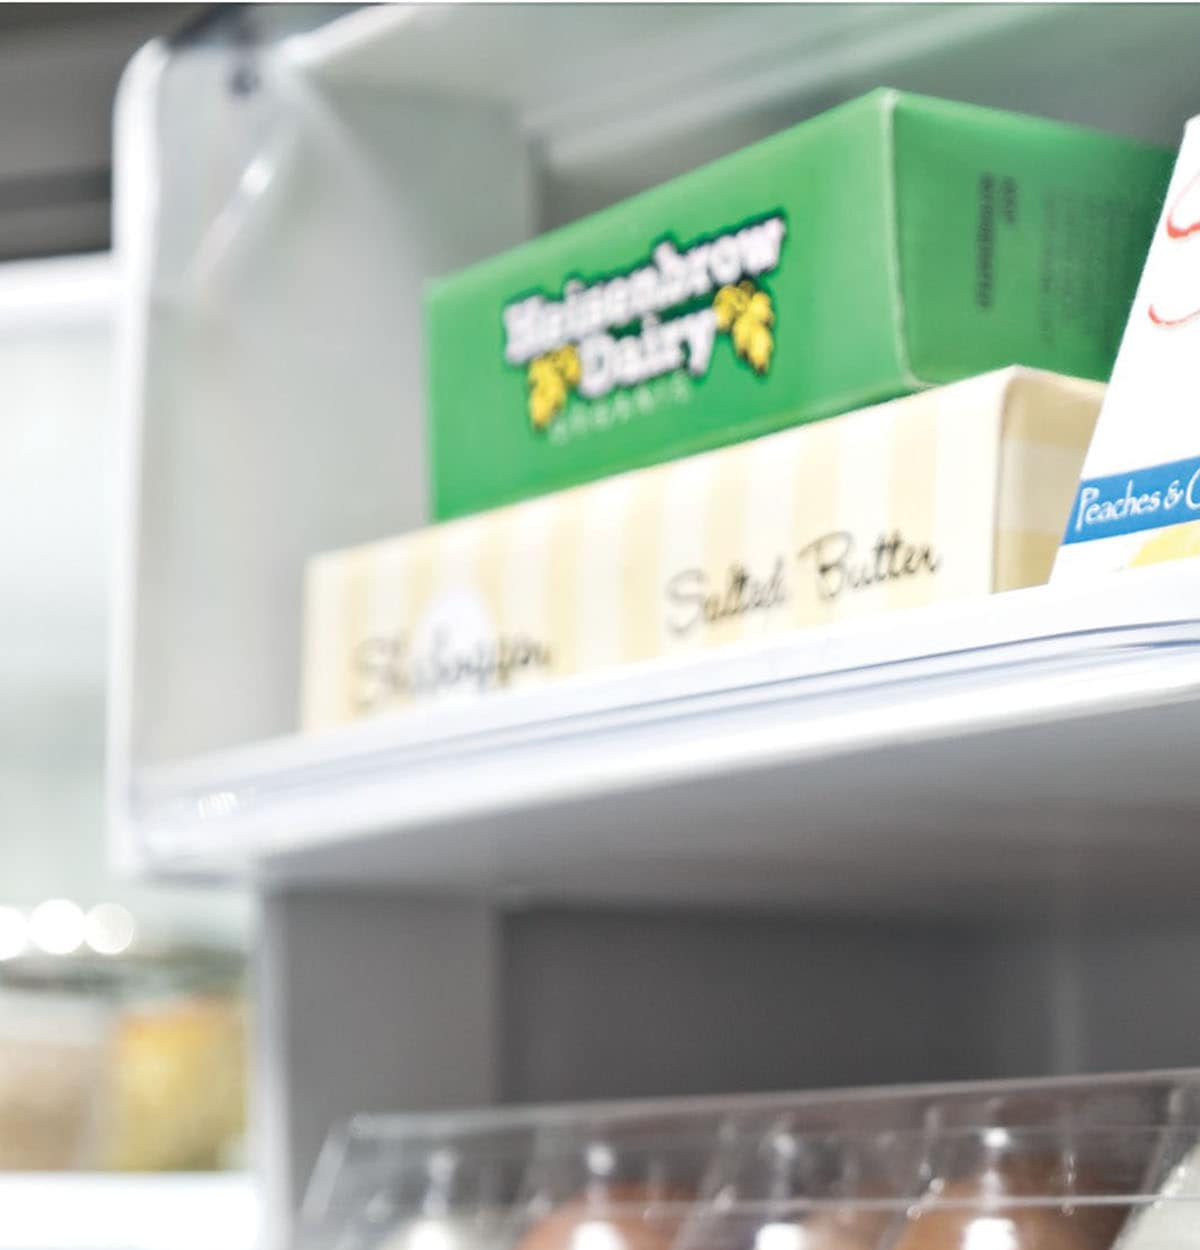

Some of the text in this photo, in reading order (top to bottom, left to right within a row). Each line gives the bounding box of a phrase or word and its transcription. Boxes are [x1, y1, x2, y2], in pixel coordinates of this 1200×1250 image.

[578, 306, 717, 397] Dairy
[1074, 478, 1162, 533] Peaches
[1163, 479, 1185, 511] &
[664, 529, 942, 638] Salted Butter
